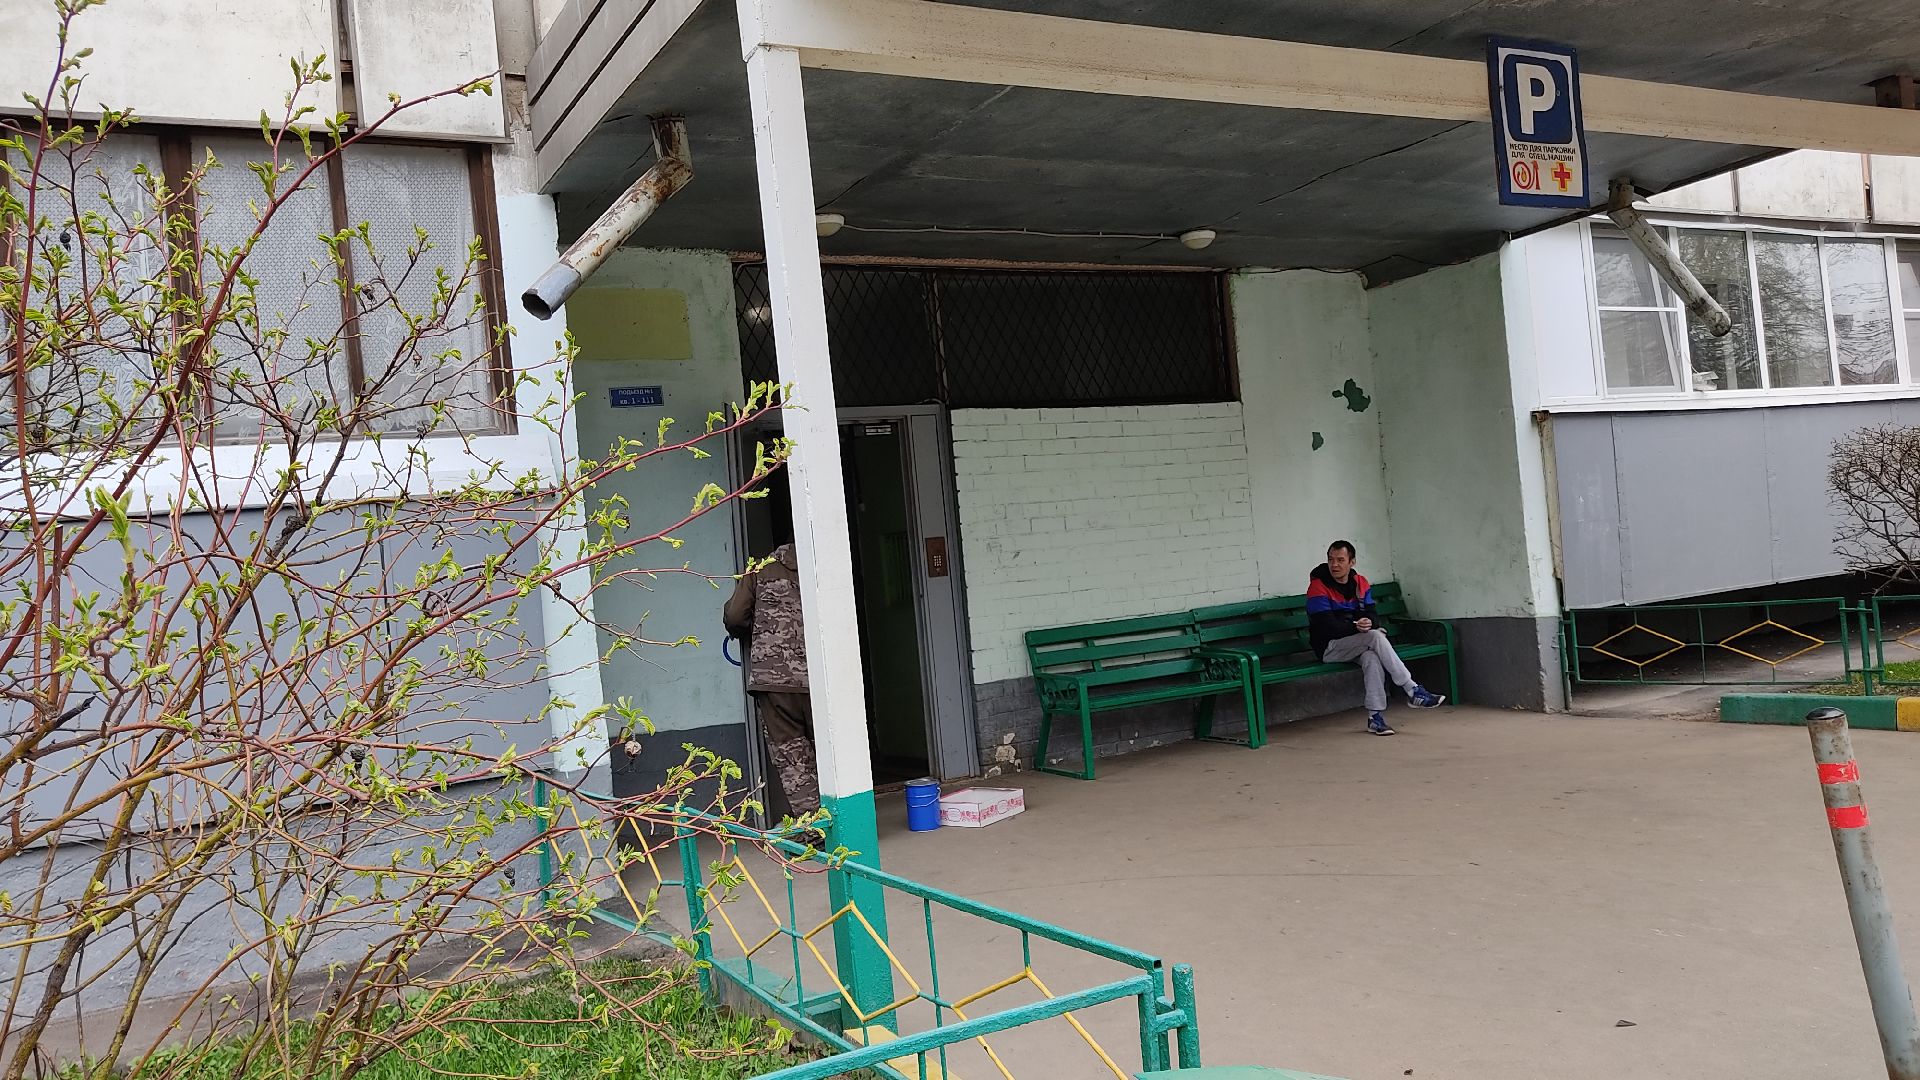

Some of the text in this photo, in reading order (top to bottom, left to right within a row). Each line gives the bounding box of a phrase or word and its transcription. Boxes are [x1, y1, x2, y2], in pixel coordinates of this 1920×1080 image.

[1516, 63, 1556, 134] P
[1510, 143, 1528, 151] МЕСТО
[1543, 146, 1575, 154] ПАРКОВКИ
